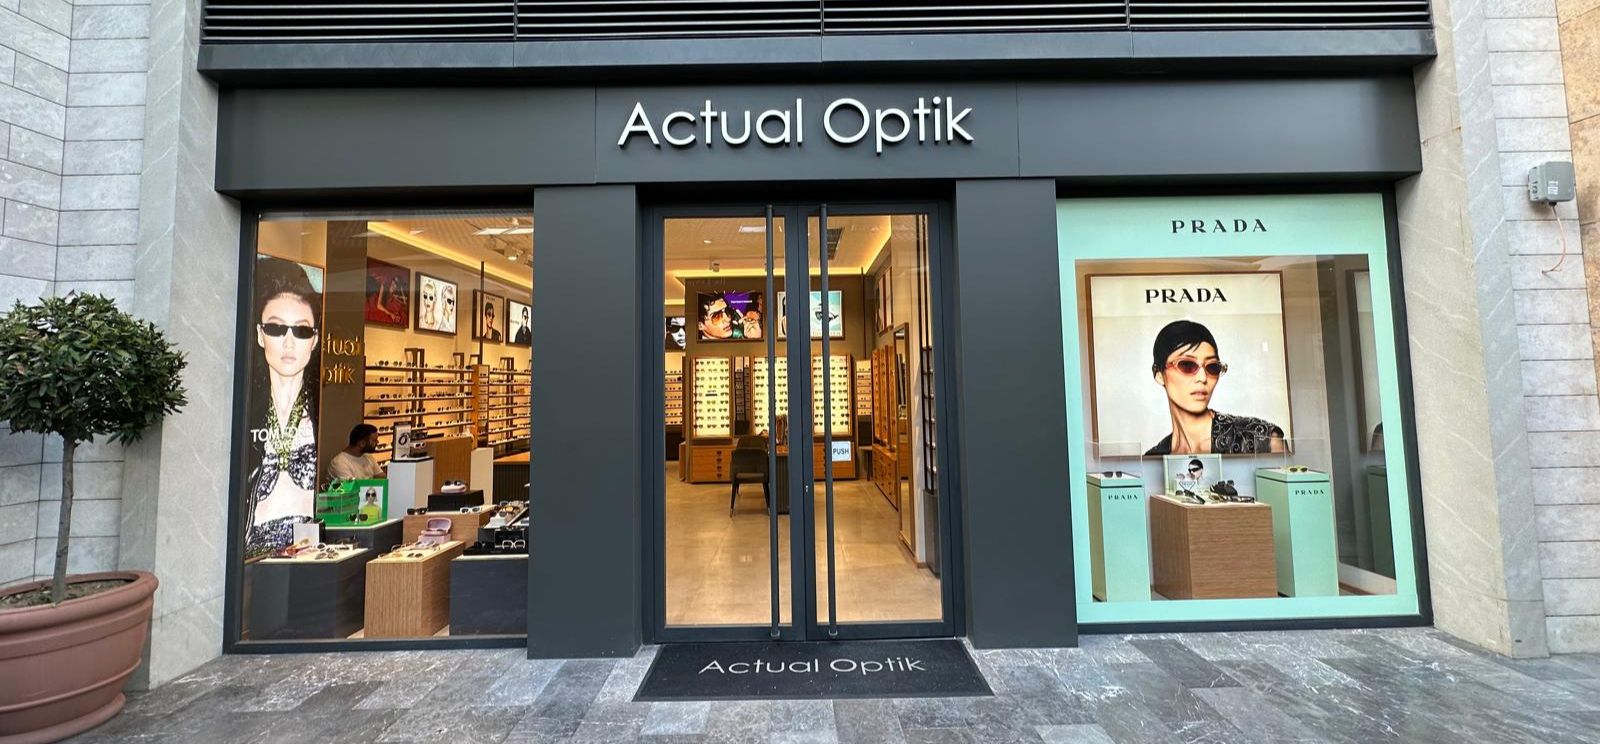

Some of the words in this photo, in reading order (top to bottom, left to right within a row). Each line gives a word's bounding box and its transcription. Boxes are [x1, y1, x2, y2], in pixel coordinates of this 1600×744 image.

[617, 98, 803, 146] Actual
[823, 96, 975, 155] Optik
[1171, 218, 1268, 233] PRADA
[1145, 287, 1228, 303] PRADA
[250, 427, 279, 443] TOM
[832, 447, 850, 455] PUSH
[698, 658, 819, 675] Actual
[829, 656, 926, 676] Optik
